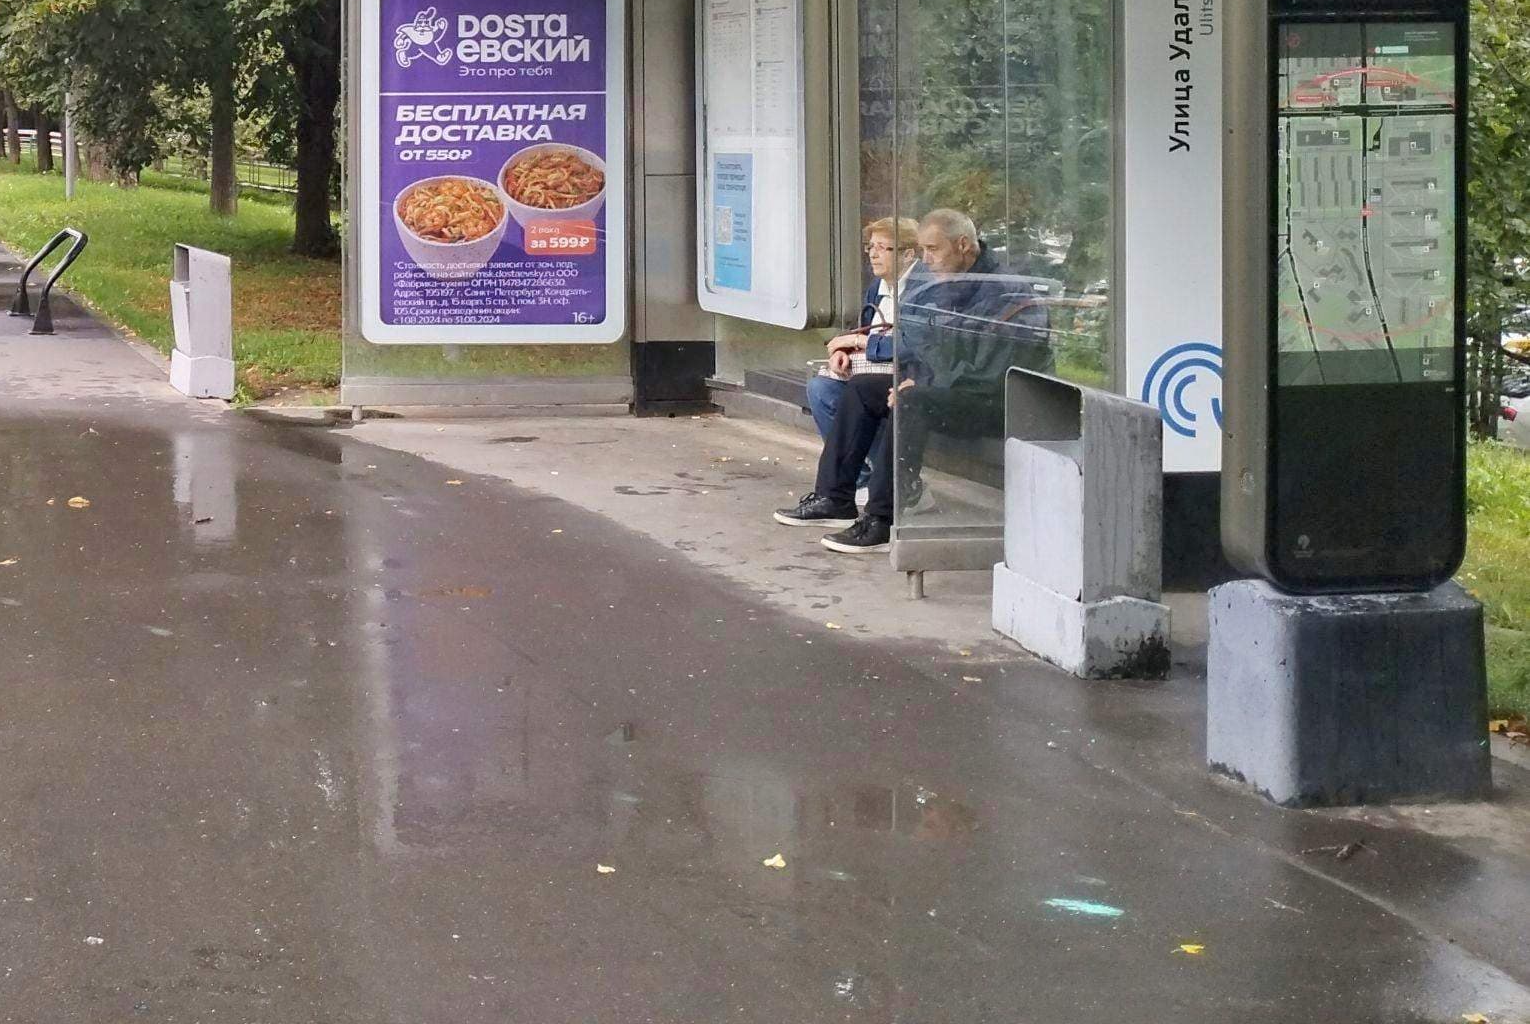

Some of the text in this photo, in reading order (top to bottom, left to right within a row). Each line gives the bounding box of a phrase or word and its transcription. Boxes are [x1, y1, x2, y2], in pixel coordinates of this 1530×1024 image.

[458, 65, 553, 79] Это про тебя
[395, 104, 587, 122] БЕСПЛАТНАЯ
[1169, 68, 1193, 152] Улица
[394, 124, 553, 145] ДОСТАВКА
[530, 239, 547, 248] за
[556, 269, 579, 277] ООО
[572, 311, 596, 324] 16+
